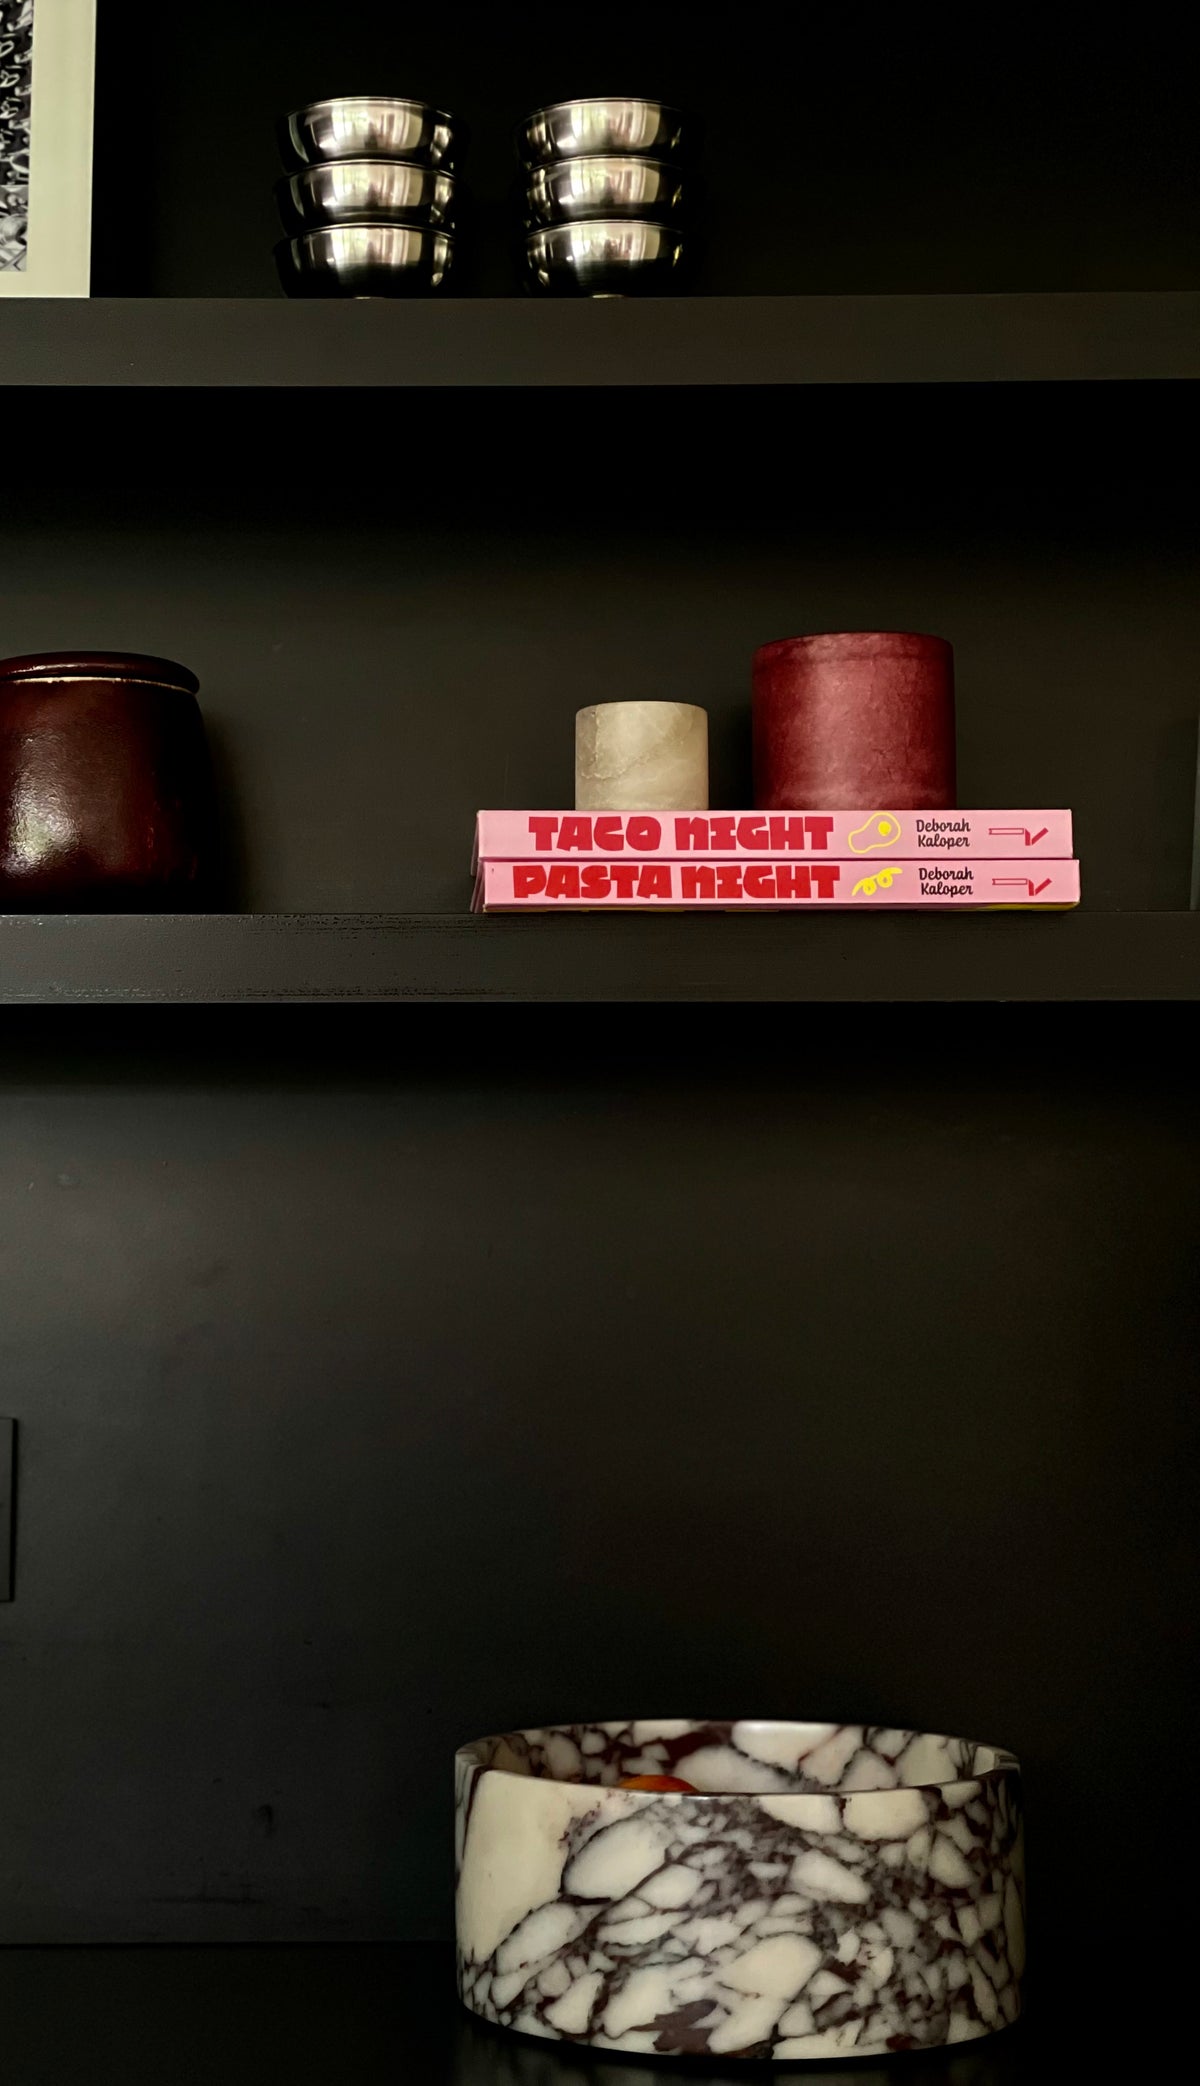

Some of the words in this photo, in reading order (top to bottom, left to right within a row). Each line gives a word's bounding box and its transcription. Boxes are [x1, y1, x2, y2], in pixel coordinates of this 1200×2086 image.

[916, 818, 970, 833] Deborah
[528, 816, 662, 852] TACO
[674, 816, 834, 850] NIGHT
[917, 834, 970, 849] Kaloper
[512, 864, 672, 900] PASTA
[680, 865, 840, 898] NIGHT
[918, 867, 974, 882] Deborah
[920, 882, 973, 898] Kaloper
